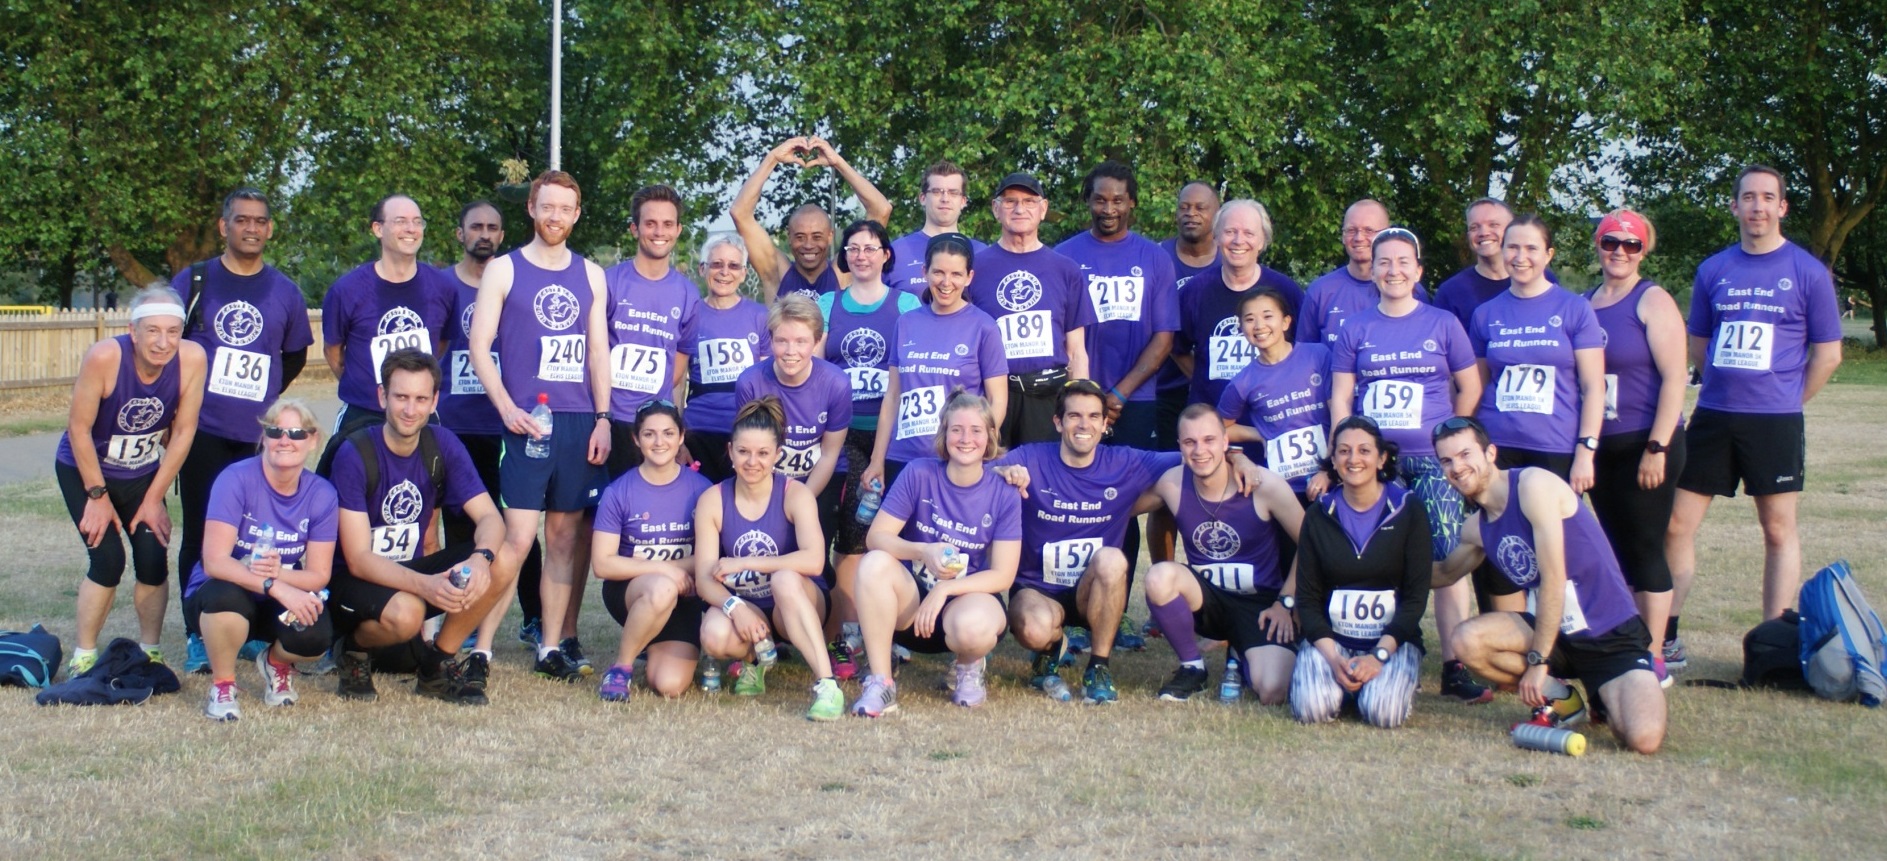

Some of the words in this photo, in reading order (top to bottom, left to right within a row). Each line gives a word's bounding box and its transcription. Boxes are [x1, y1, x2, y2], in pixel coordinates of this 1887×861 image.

[1096, 279, 1136, 305] 213
[1727, 287, 1752, 296] East
[1753, 287, 1774, 297] End
[1715, 302, 1740, 311] Road
[1743, 301, 1785, 313] Runners
[628, 308, 650, 319] East
[650, 312, 668, 324] End
[614, 320, 640, 332] Road
[642, 323, 674, 341] Runners
[1005, 314, 1043, 341] 189
[1500, 327, 1523, 335] East
[1525, 326, 1546, 334] End
[1513, 339, 1559, 348] Runners
[1722, 324, 1763, 350] 212
[549, 338, 584, 364] 240
[706, 341, 745, 367] 158
[907, 351, 929, 360] East
[930, 351, 950, 361] End
[1217, 339, 1257, 363] 244
[1370, 352, 1397, 362] East
[1400, 350, 1422, 360] End
[1733, 351, 1753, 359] MANOR
[224, 352, 263, 382] 136
[619, 346, 659, 375] 175
[1737, 359, 1758, 367] LEAGUE
[898, 364, 916, 374] oad
[918, 364, 960, 377] Runners
[1361, 367, 1387, 377] Road
[1390, 365, 1436, 375] Runners
[234, 379, 253, 389] MANOR
[635, 382, 655, 391] LEAGUE
[1505, 367, 1546, 393] 179
[222, 386, 237, 394] ELVIS
[237, 389, 258, 398] LEAGUE
[1266, 394, 1290, 408] East
[1290, 388, 1312, 400] End
[1372, 384, 1413, 410] 159
[902, 389, 937, 421] 233
[795, 425, 817, 434] End
[916, 426, 936, 434] LEAGUE
[119, 434, 158, 459] 155
[1276, 430, 1318, 464] 153
[774, 449, 814, 472] 248
[1053, 499, 1078, 510] East
[1081, 501, 1102, 511] End
[931, 513, 953, 529] East
[955, 522, 978, 536] End
[1037, 510, 1065, 523] Road
[1068, 514, 1112, 524] Runners
[248, 525, 263, 537] Ea
[276, 530, 299, 542] End
[641, 522, 666, 533] East
[670, 521, 691, 532] End
[628, 535, 655, 545] Road
[659, 536, 694, 545] Runne
[941, 533, 985, 550] Runners
[275, 545, 305, 555] nners
[1054, 542, 1094, 569] 152
[1341, 594, 1385, 621] 166
[1355, 622, 1377, 630] MANOR
